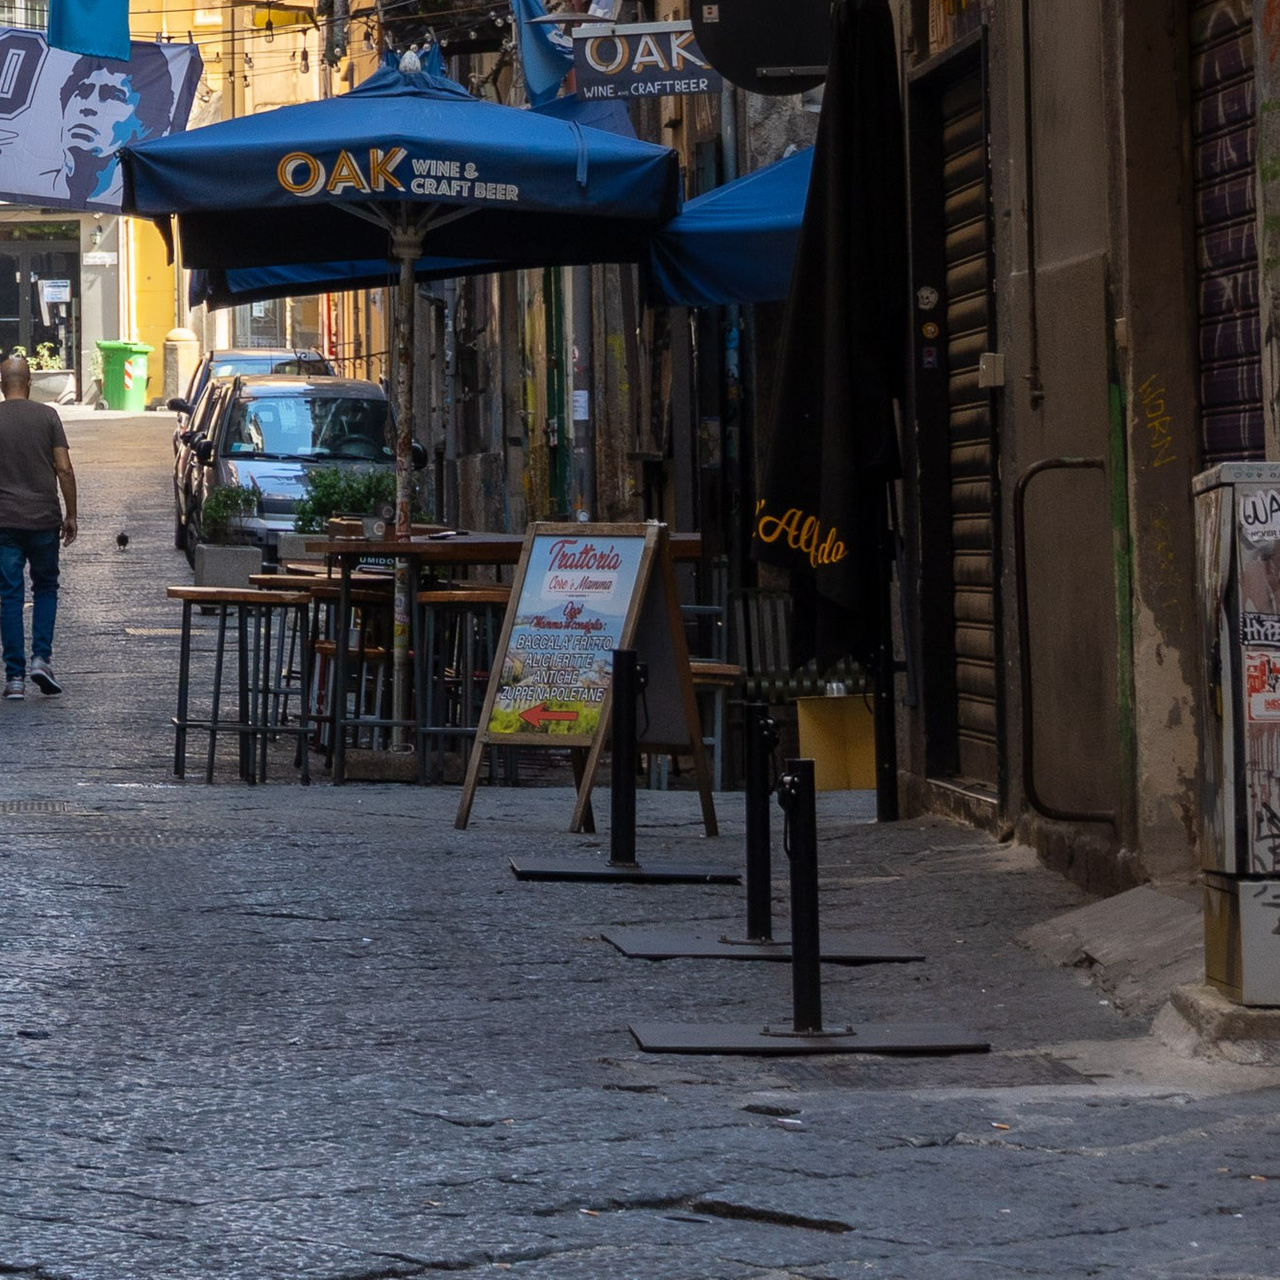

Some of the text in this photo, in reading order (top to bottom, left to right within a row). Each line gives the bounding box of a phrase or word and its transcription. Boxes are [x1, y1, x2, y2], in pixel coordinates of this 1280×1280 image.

[584, 31, 713, 75] OAK
[584, 84, 615, 98] WINE
[277, 147, 408, 197] OAK
[411, 158, 479, 179] WINE &
[410, 178, 519, 201] CRAFT BEER
[359, 557, 394, 565] UMIDO
[548, 539, 623, 572] Trattoria
[548, 575, 568, 590] Core
[574, 575, 613, 591] Mamma
[572, 635, 613, 651] FRITTO
[524, 652, 595, 668] ALICI FRITTE
[531, 669, 580, 684] ANTICHE
[500, 685, 605, 702] ZUPPE NAPOLETANE
